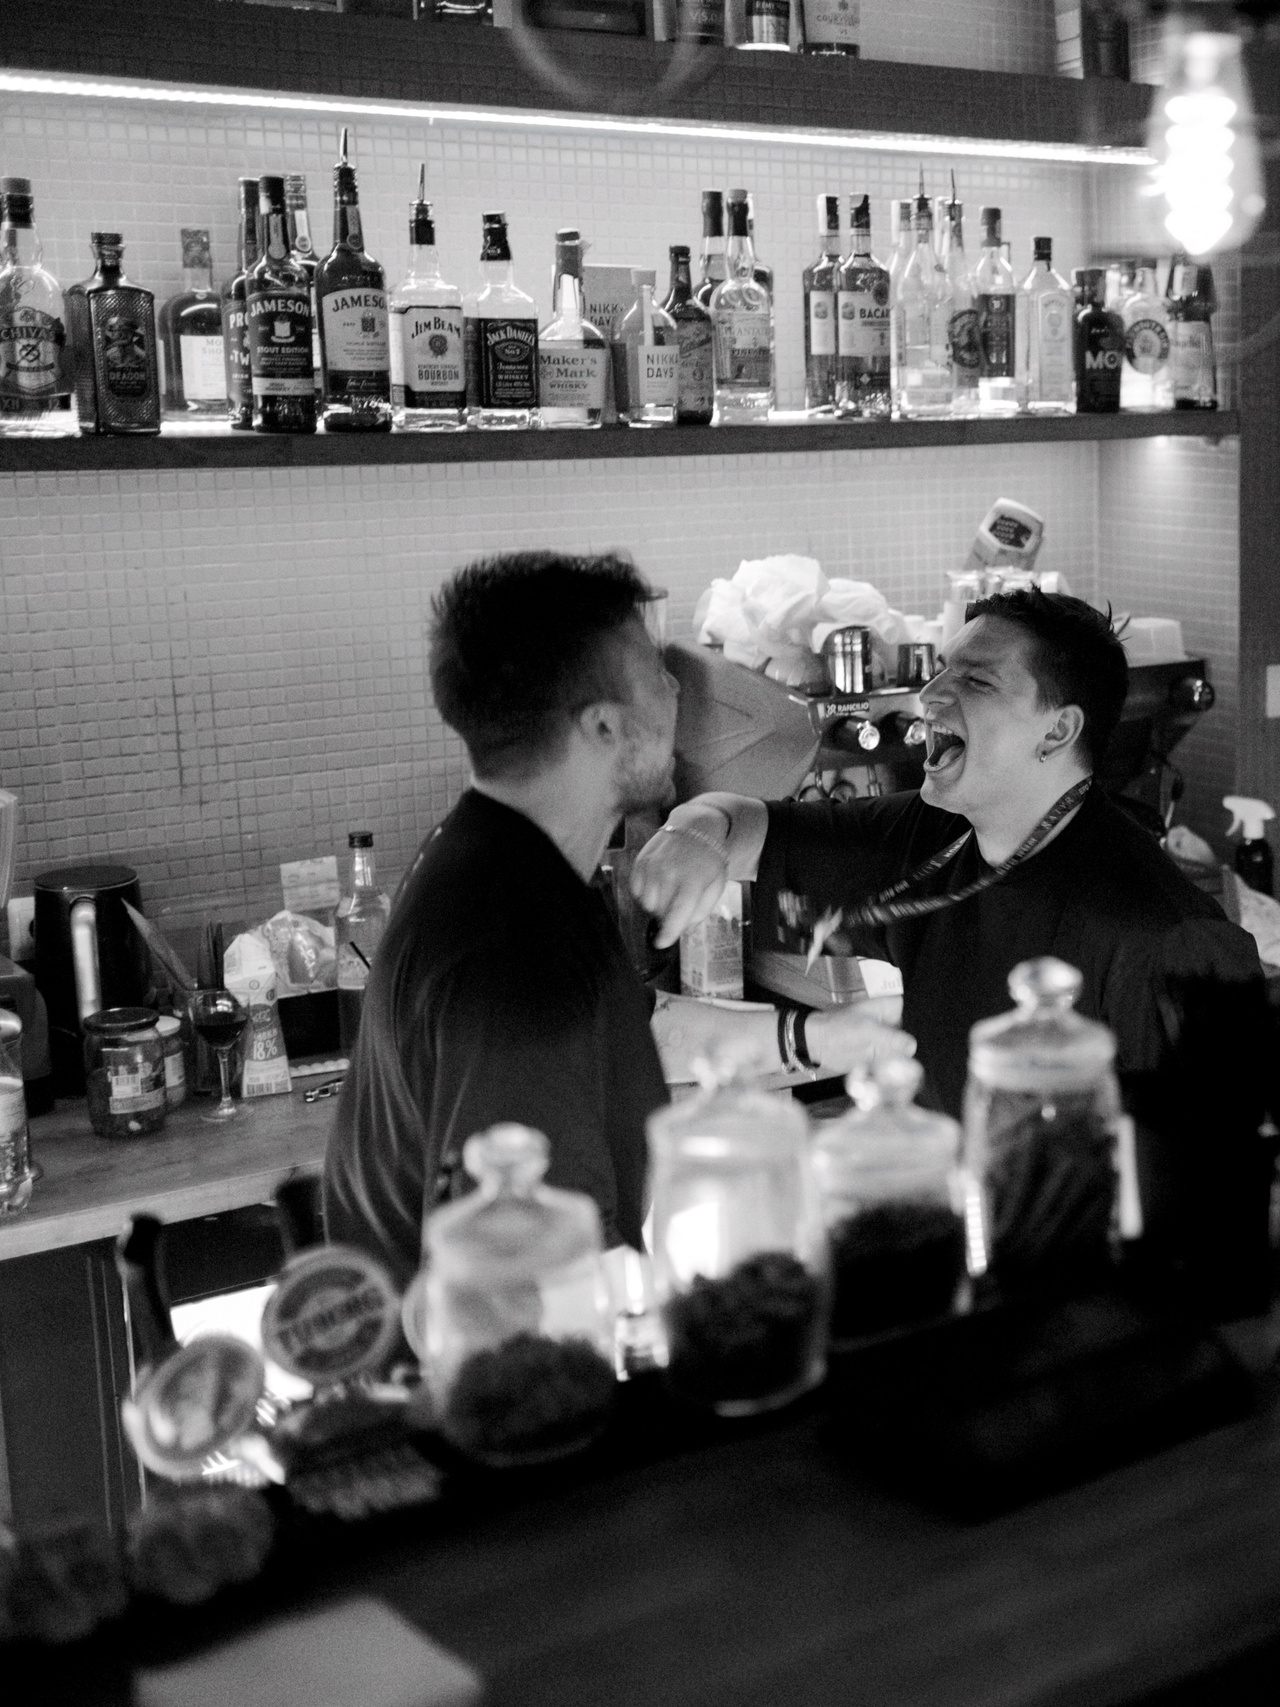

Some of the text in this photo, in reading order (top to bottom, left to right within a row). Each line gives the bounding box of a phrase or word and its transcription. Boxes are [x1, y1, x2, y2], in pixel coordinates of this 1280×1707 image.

[250, 298, 310, 318] JAMESON
[0, 326, 56, 341] CHIVAS
[411, 316, 461, 340] JIM BEAM
[486, 329, 507, 347] JACK
[256, 346, 280, 355] STOUT
[540, 355, 598, 366] Maker's
[417, 369, 460, 381] BOURBON
[556, 368, 598, 379] Mark
[646, 367, 675, 379] DAYS
[549, 382, 589, 390] WHISKY
[837, 702, 870, 713] RANCILIO
[252, 1038, 278, 1062] 18%
